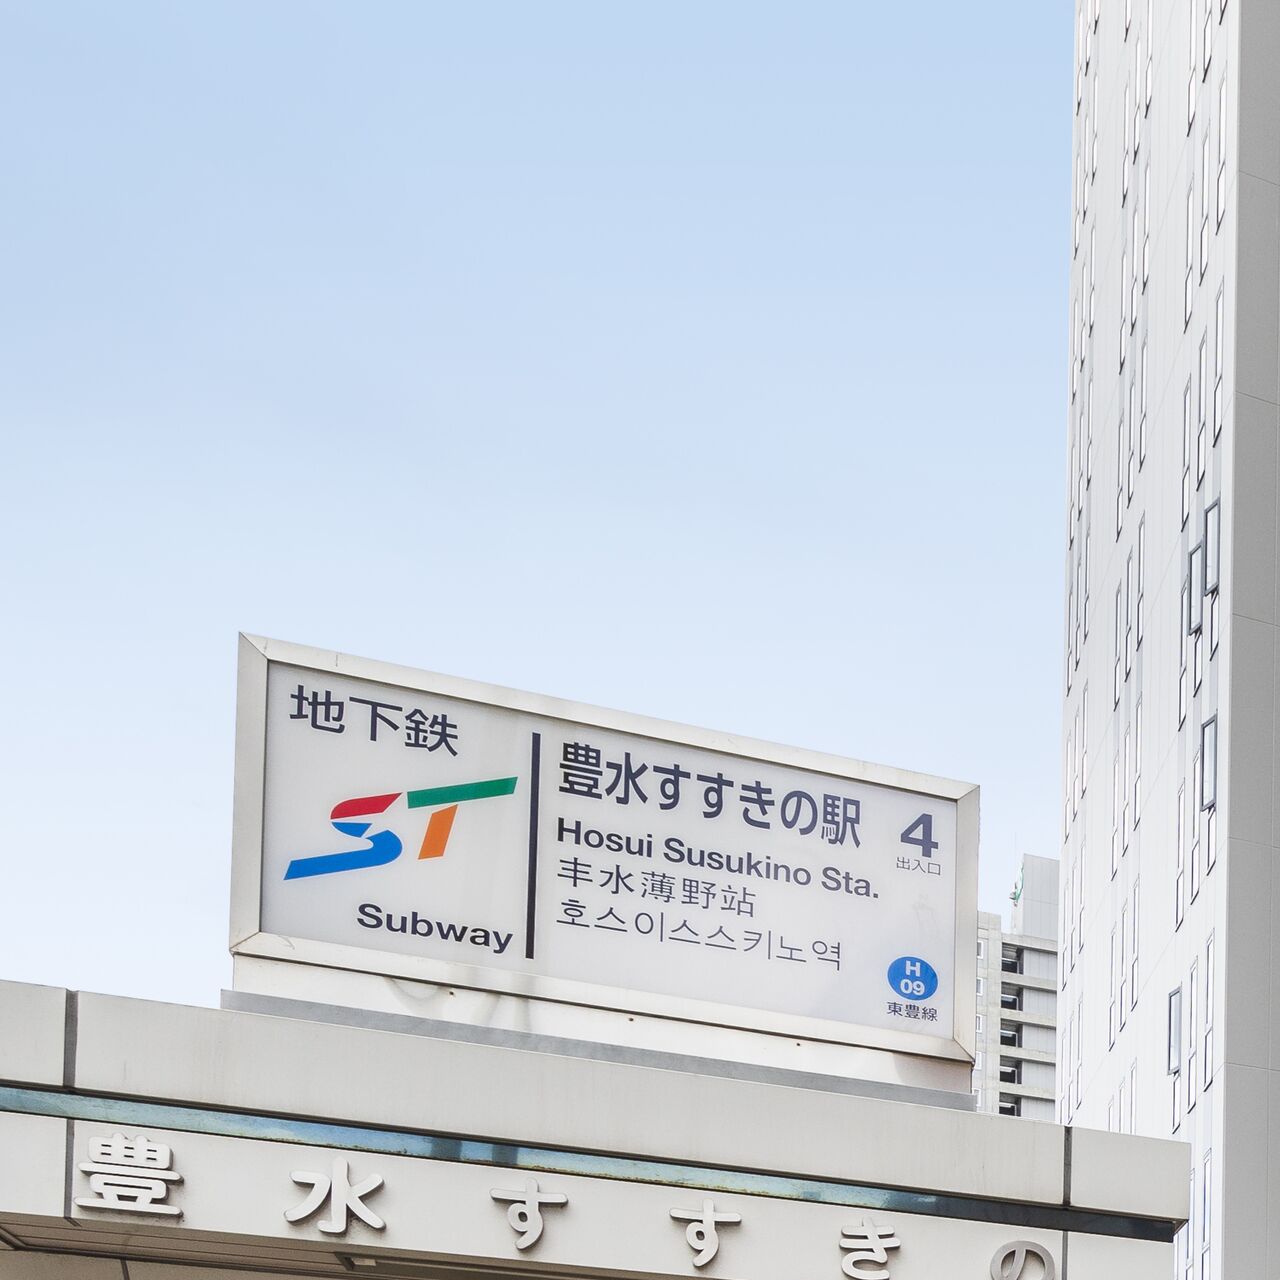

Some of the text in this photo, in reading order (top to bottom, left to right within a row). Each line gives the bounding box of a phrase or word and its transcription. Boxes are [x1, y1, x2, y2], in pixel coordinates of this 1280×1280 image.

[289, 684, 459, 757] 地下鉄
[558, 741, 862, 849] 豊水すすきの駅
[557, 816, 880, 899] Hosui Susukino Sta.
[899, 812, 939, 858] 4
[556, 856, 758, 918] 丰水薄野站
[895, 855, 942, 876] 出入口
[356, 902, 514, 954] Subway
[556, 899, 842, 971] 호스이스스키노역
[900, 979, 925, 996] 09
[905, 960, 921, 977] H
[886, 1001, 938, 1022] 東豊線
